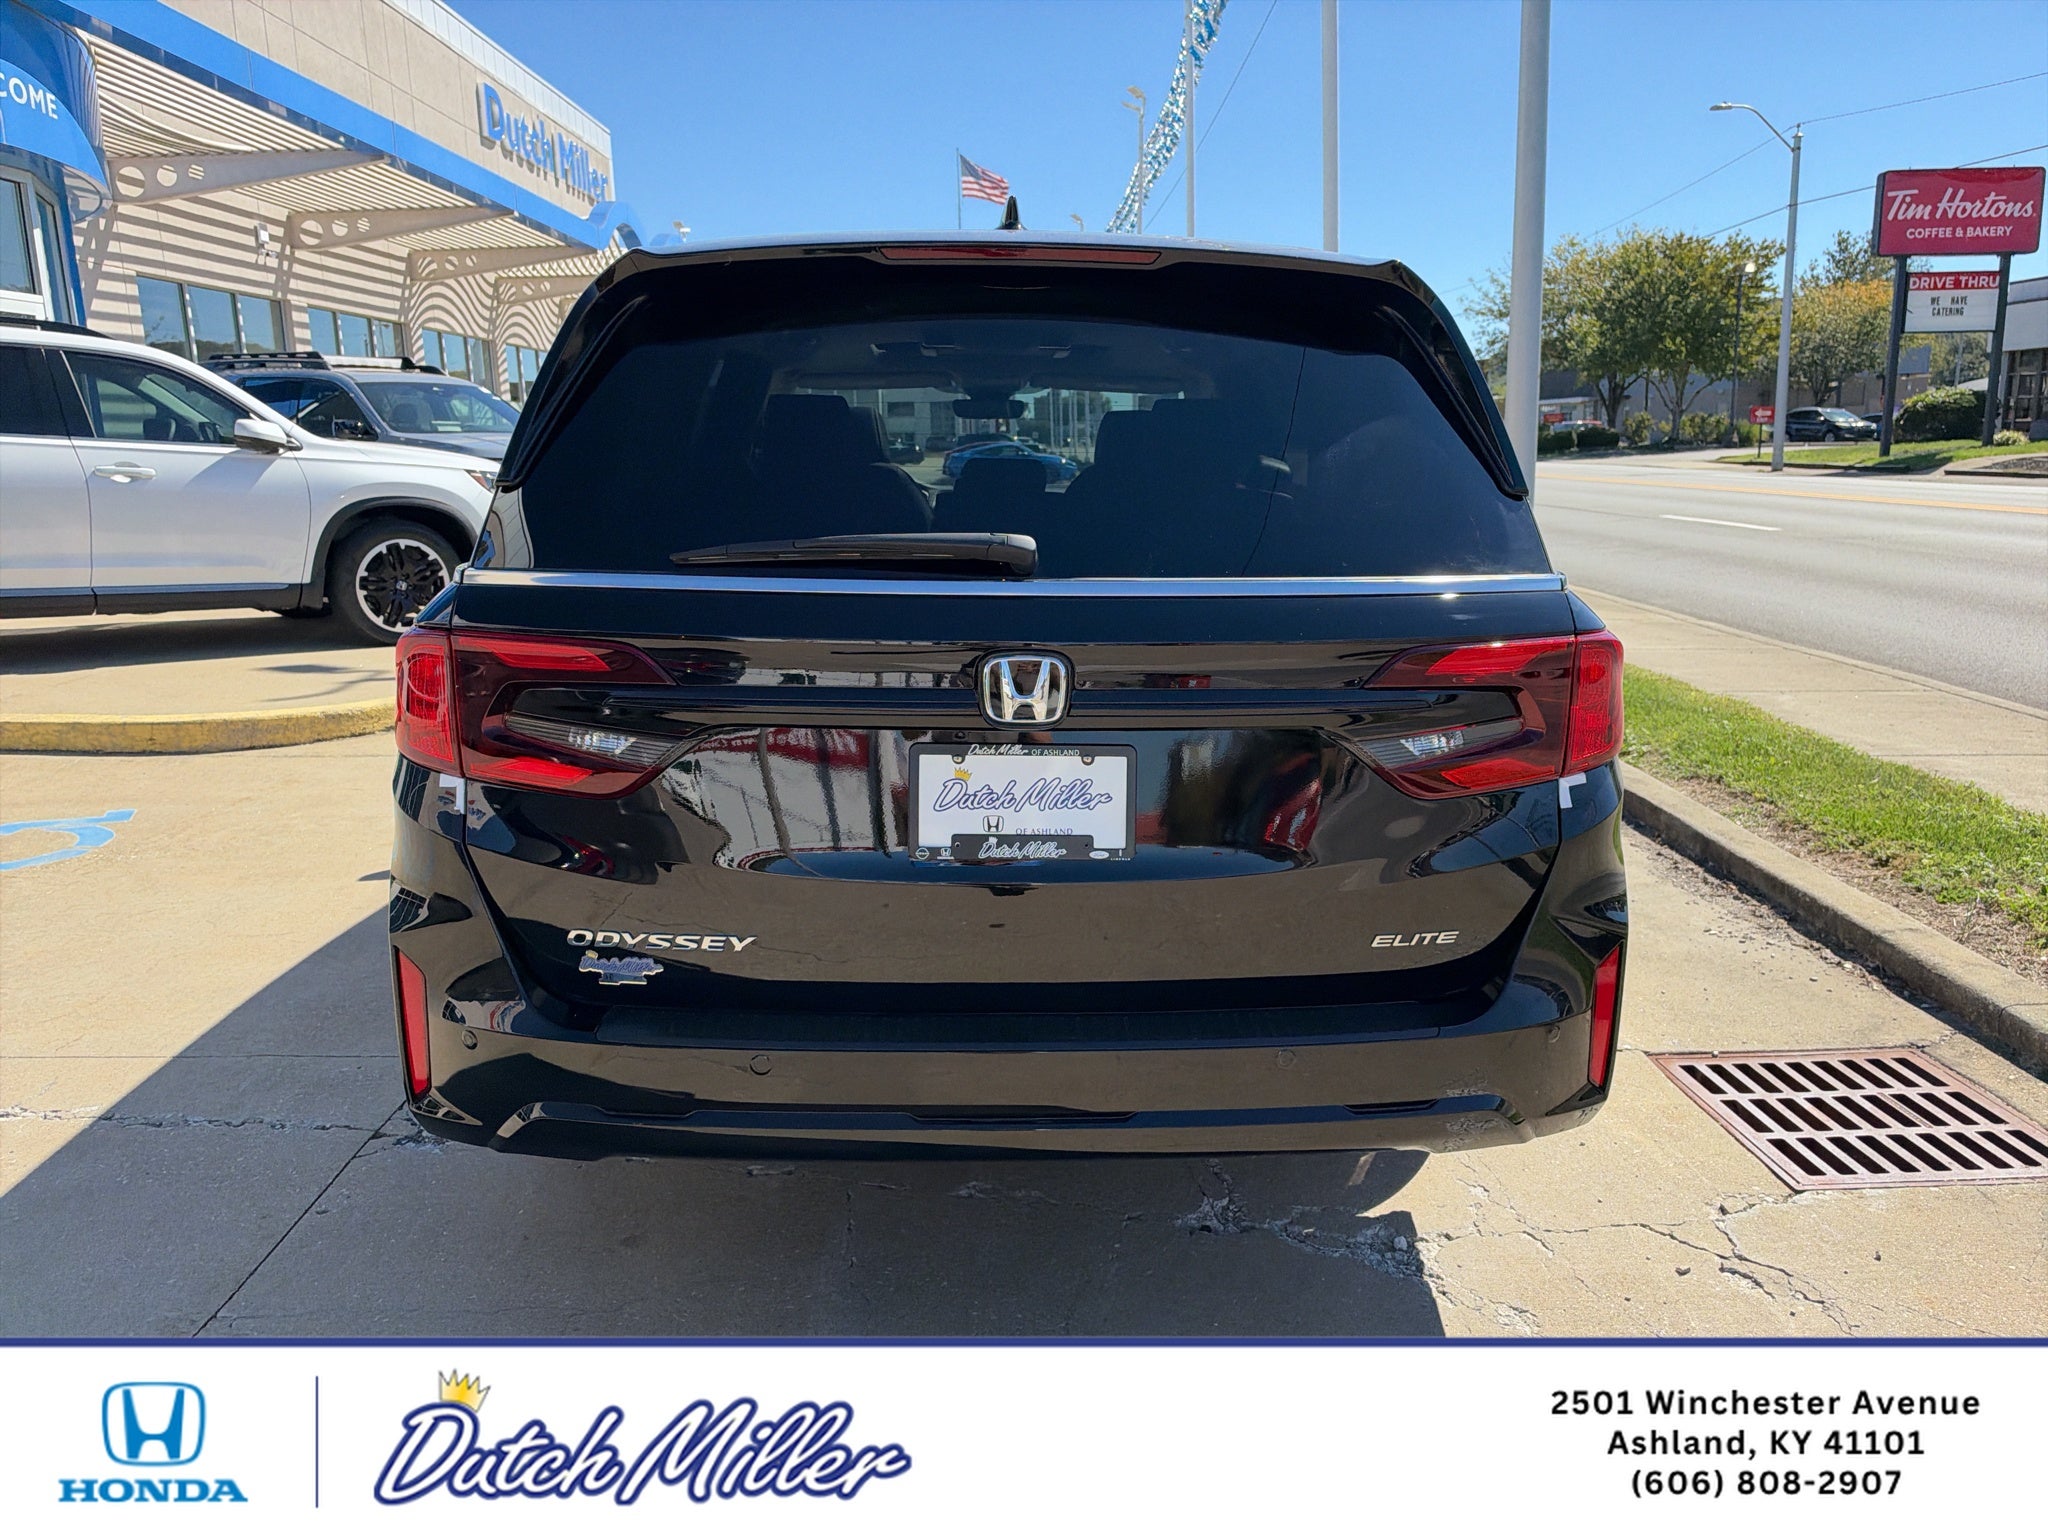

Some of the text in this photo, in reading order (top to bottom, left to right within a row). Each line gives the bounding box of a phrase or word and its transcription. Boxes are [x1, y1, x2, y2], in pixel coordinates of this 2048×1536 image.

[482, 82, 609, 201] Dutch Miller
[1887, 187, 2034, 221] Tim Hortons
[1906, 226, 2013, 239] COFFEE & BAKERY
[1909, 275, 2000, 290] DRIVE THRU
[1930, 296, 1968, 306] WE HAVE
[1932, 307, 1964, 316] CATERING
[967, 744, 996, 756] Dutch
[995, 744, 1029, 756] Miller
[933, 777, 1113, 812] Dutch Miller
[978, 841, 1067, 859] Dutch Miller
[566, 929, 758, 952] ODYSSEY
[1371, 931, 1460, 948] ELITE
